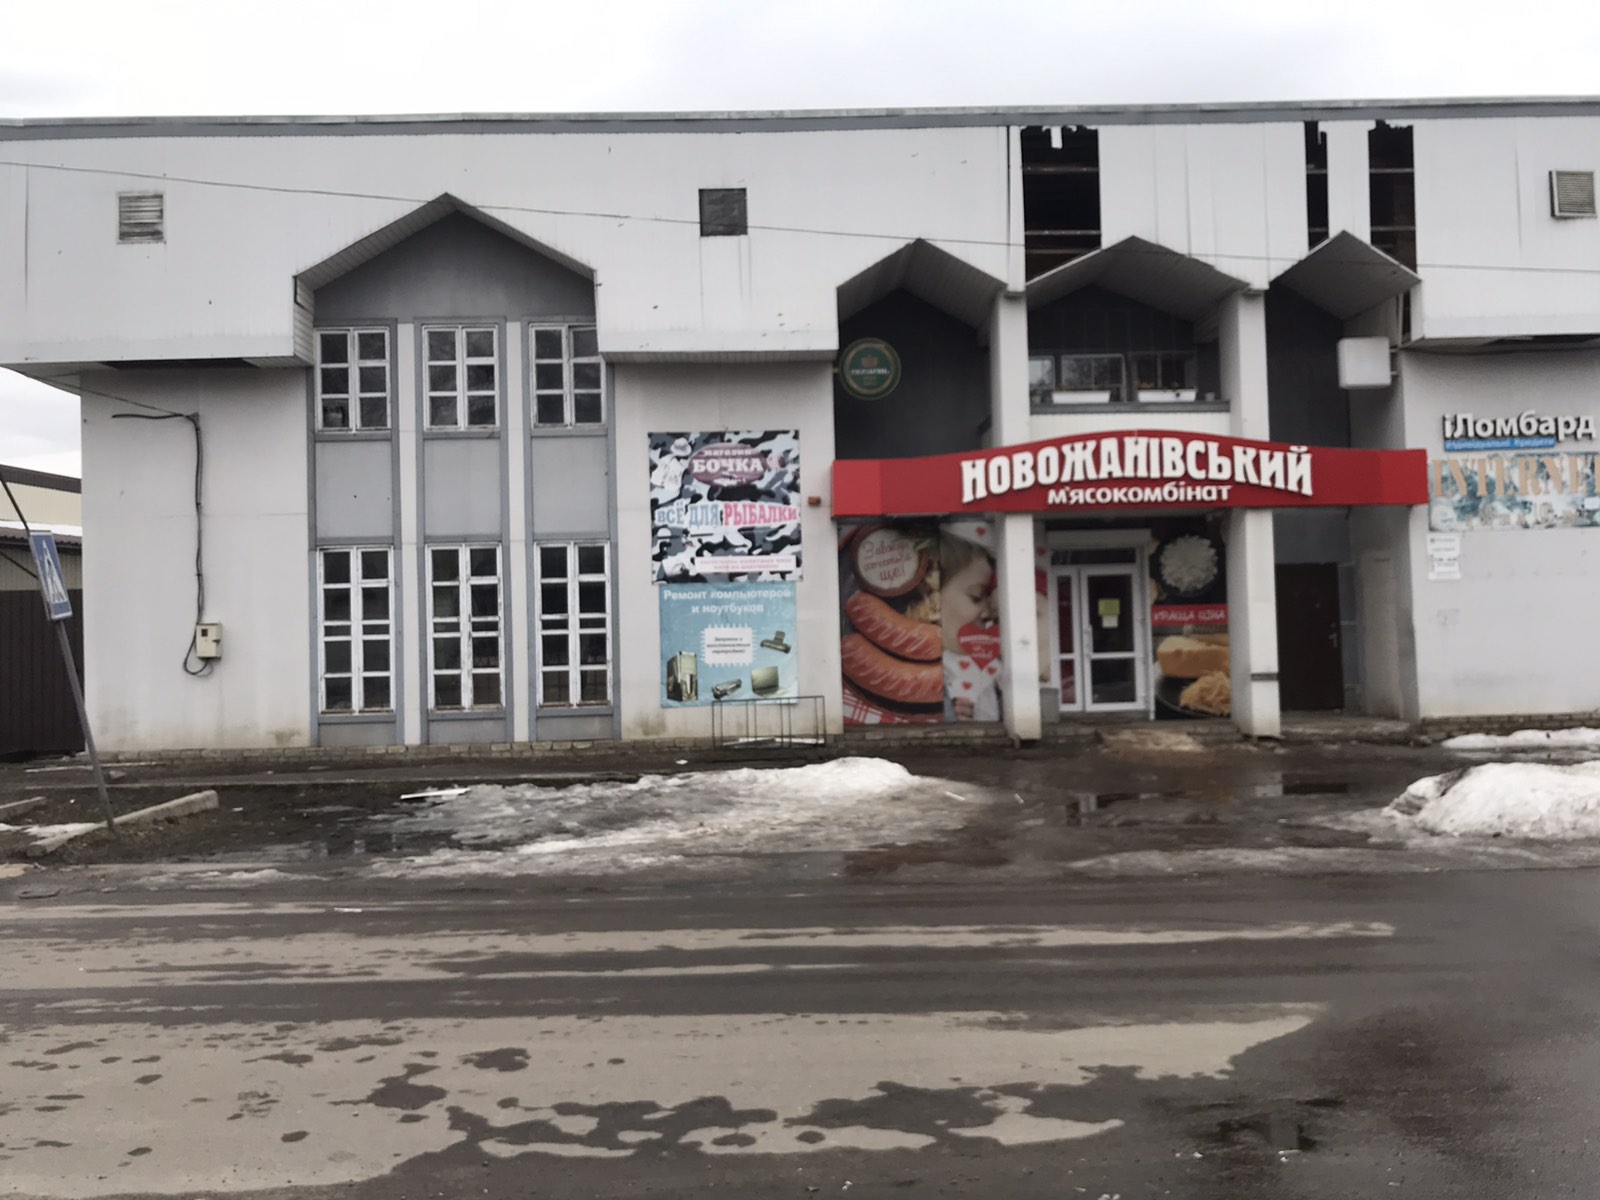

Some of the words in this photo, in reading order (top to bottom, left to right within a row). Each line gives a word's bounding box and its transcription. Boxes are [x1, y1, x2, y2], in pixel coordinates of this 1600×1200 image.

[1443, 409, 1597, 442] іЛомбард
[692, 457, 764, 474] БОЧКА
[961, 436, 1313, 504] НОВОЖАНІВСЬКИЙ
[1048, 481, 1232, 505] м'ясокомбінат
[689, 503, 719, 528] ДЛЯ
[723, 502, 798, 526] РЫБАЛКИ
[663, 589, 707, 600] Ремонт
[710, 588, 792, 600] компьютеров
[691, 605, 699, 614] и
[702, 602, 765, 615] ноутбуков
